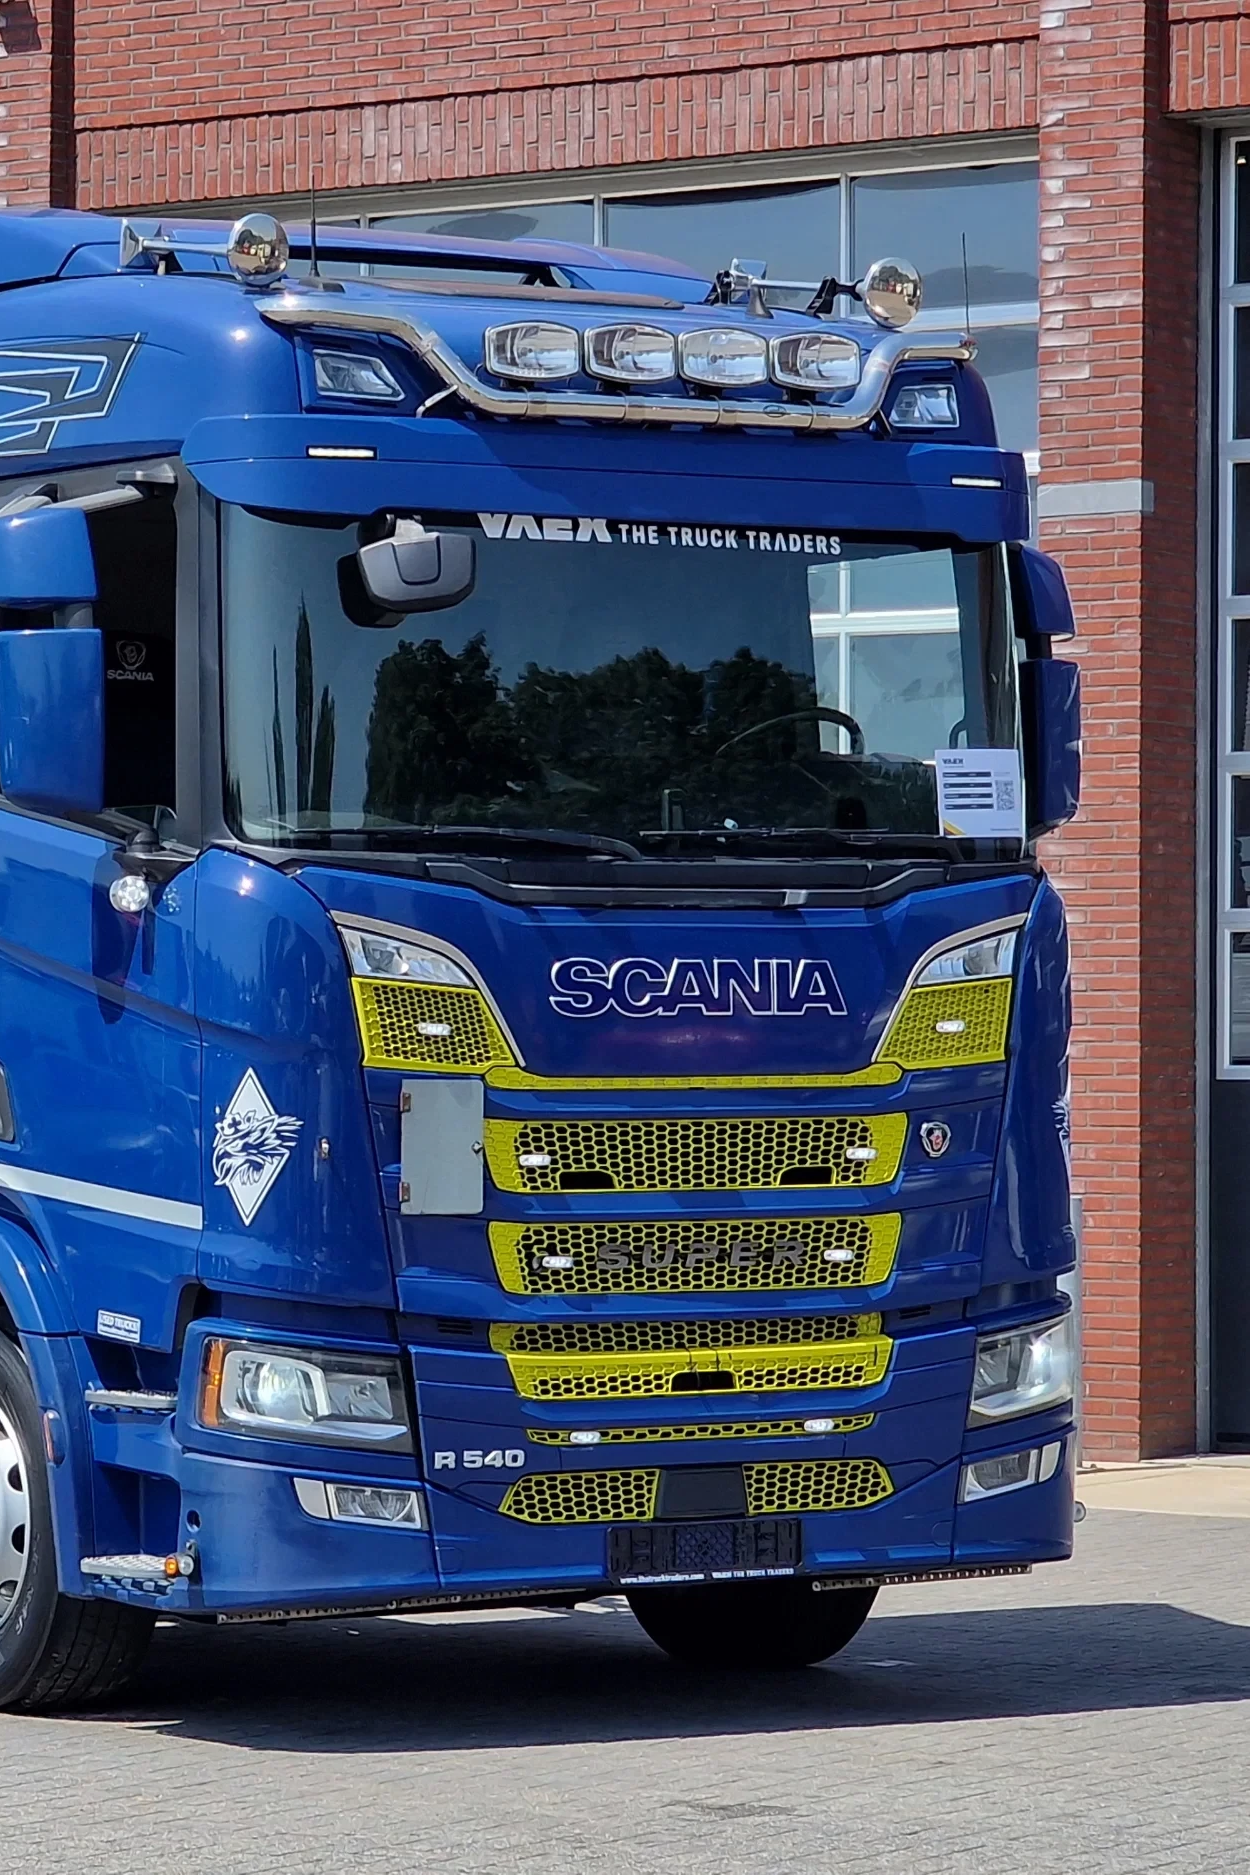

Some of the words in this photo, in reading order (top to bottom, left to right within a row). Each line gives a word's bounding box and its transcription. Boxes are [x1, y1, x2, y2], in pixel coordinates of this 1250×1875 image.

[477, 513, 613, 543] VAEX
[618, 524, 659, 545] THE
[667, 526, 739, 549] TRUCK
[746, 531, 841, 555] TRADERS
[106, 669, 155, 681] SCANIA
[549, 957, 848, 1018] SCANIA
[596, 1240, 805, 1271] SUPER
[434, 1451, 456, 1470] R
[463, 1449, 525, 1468] 540
